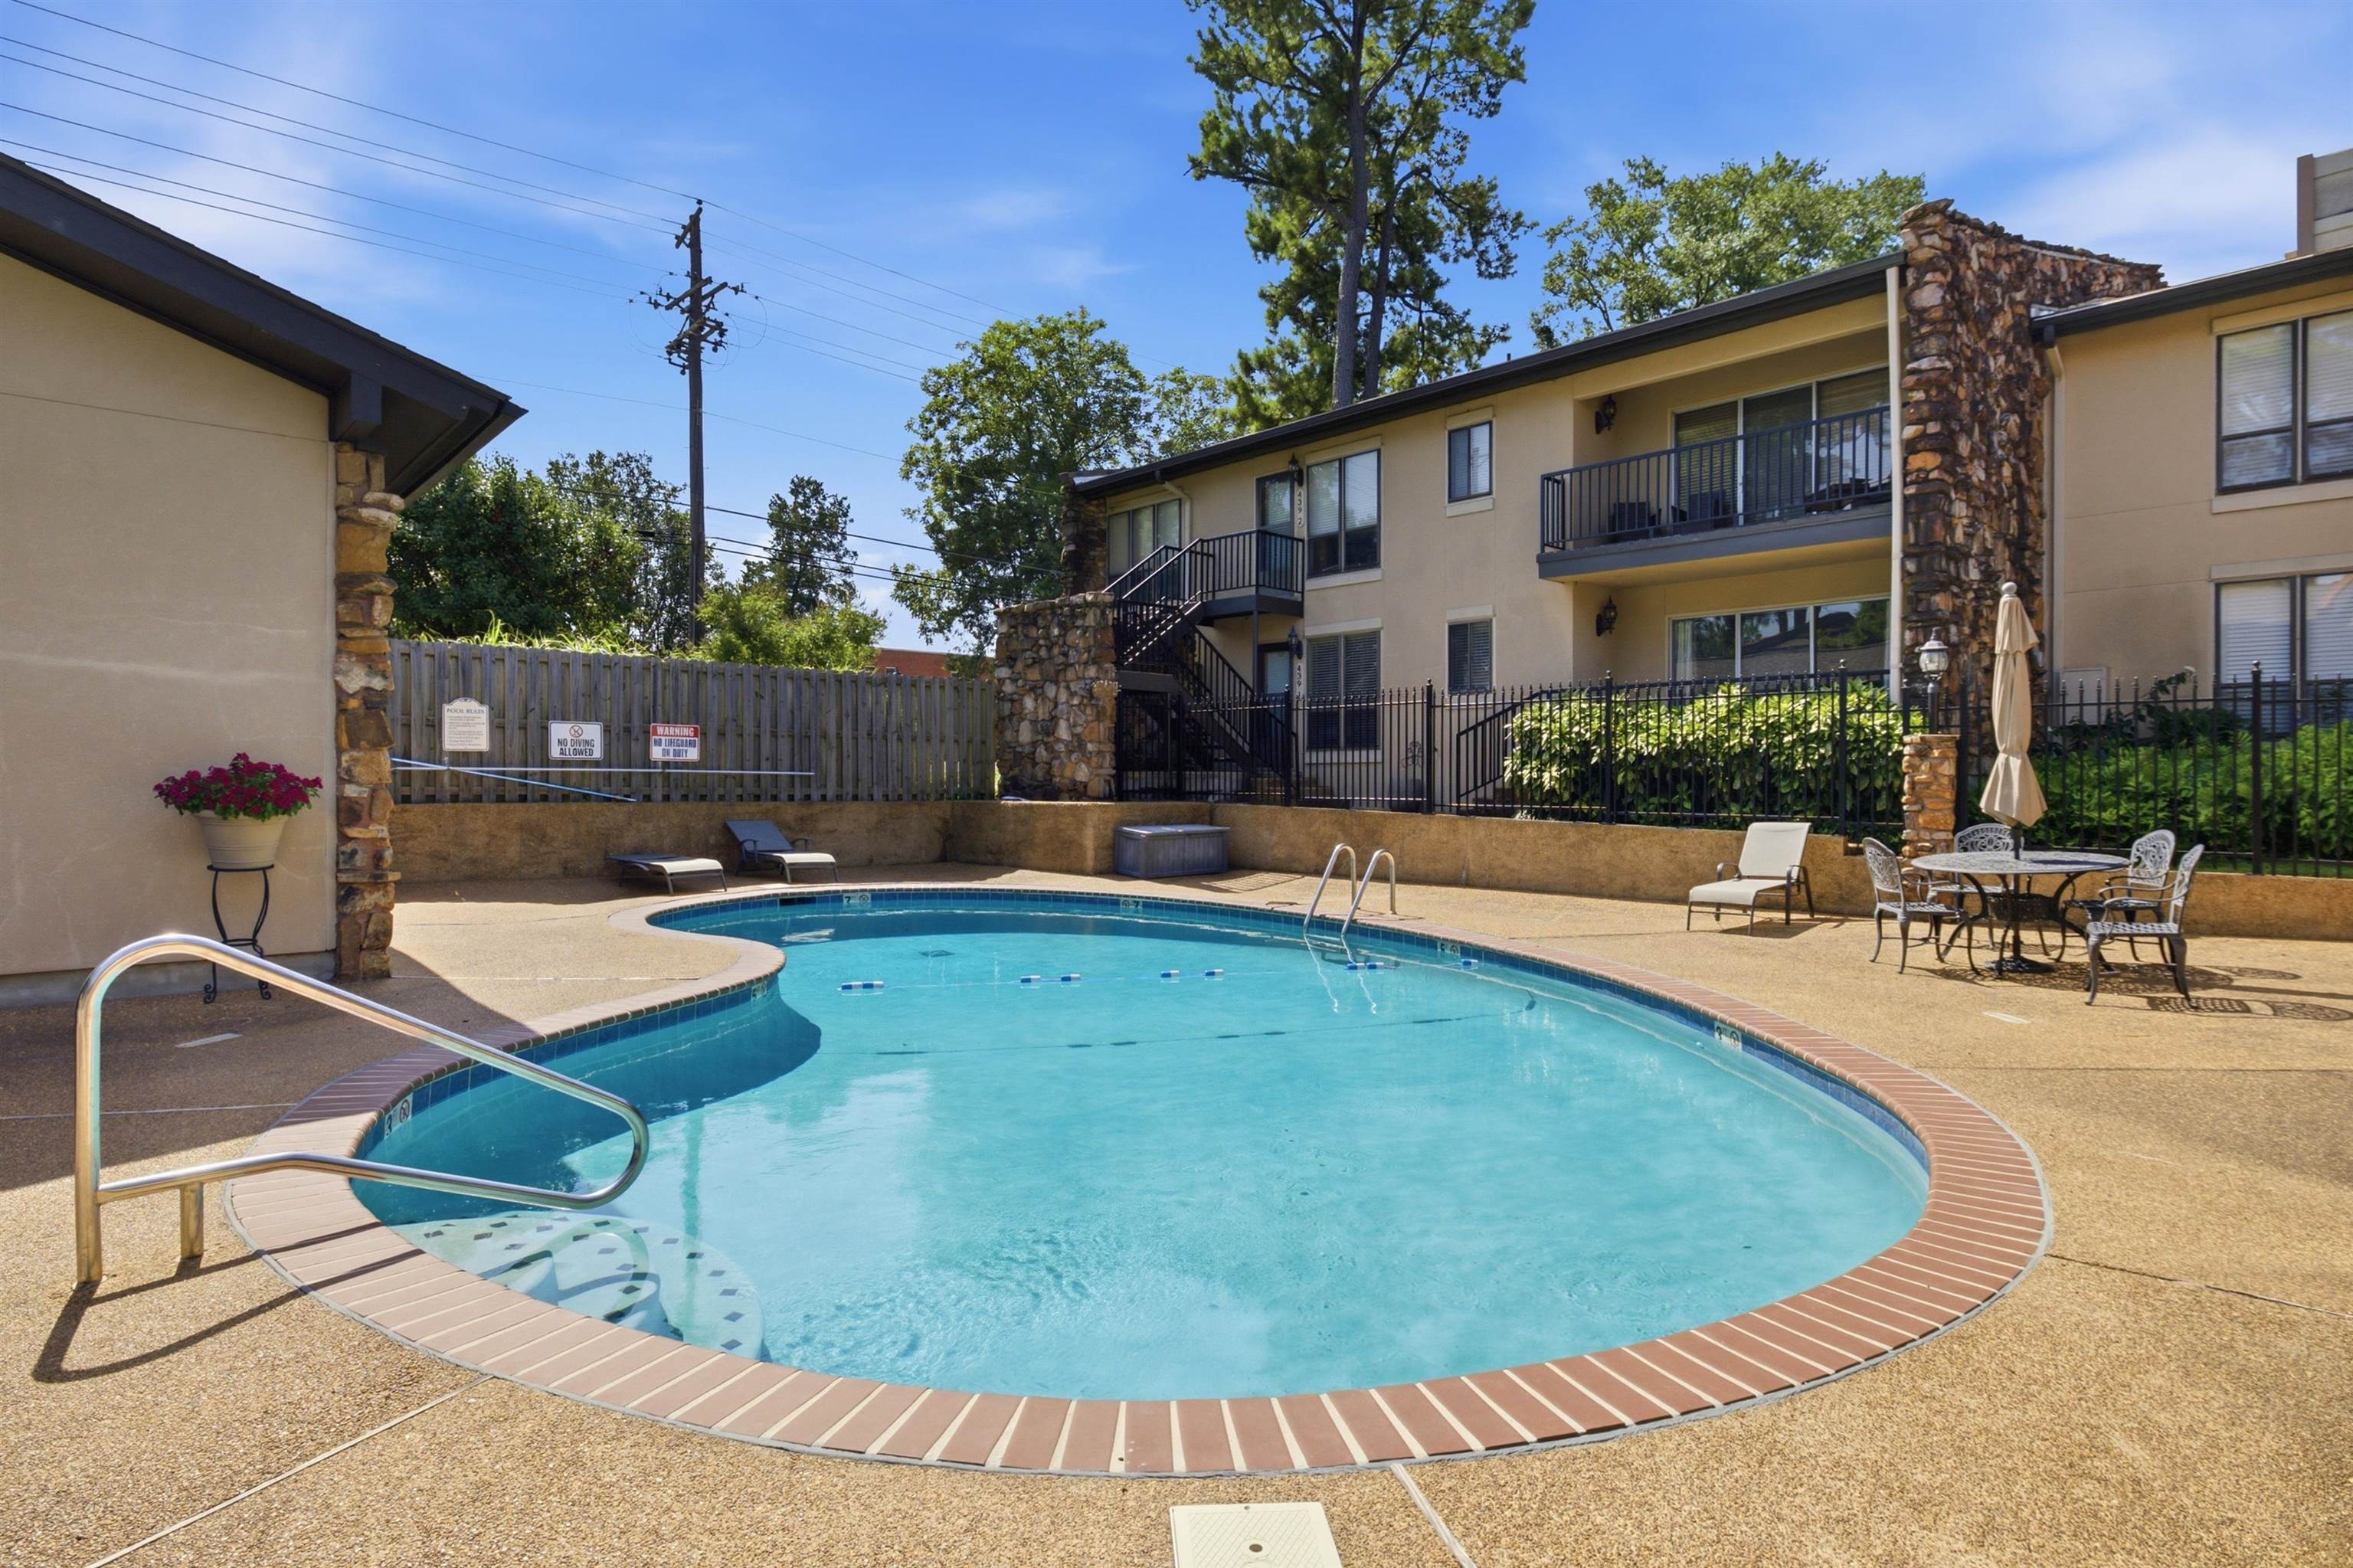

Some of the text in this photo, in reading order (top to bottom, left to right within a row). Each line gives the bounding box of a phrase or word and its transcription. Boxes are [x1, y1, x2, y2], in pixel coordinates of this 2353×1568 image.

[656, 726, 695, 736] WARNING
[557, 738, 595, 748] NO DIVING
[653, 738, 697, 748] NO LIFEGUARD
[558, 748, 594, 757] ALLOWED
[662, 748, 689, 758] ON DUTY
